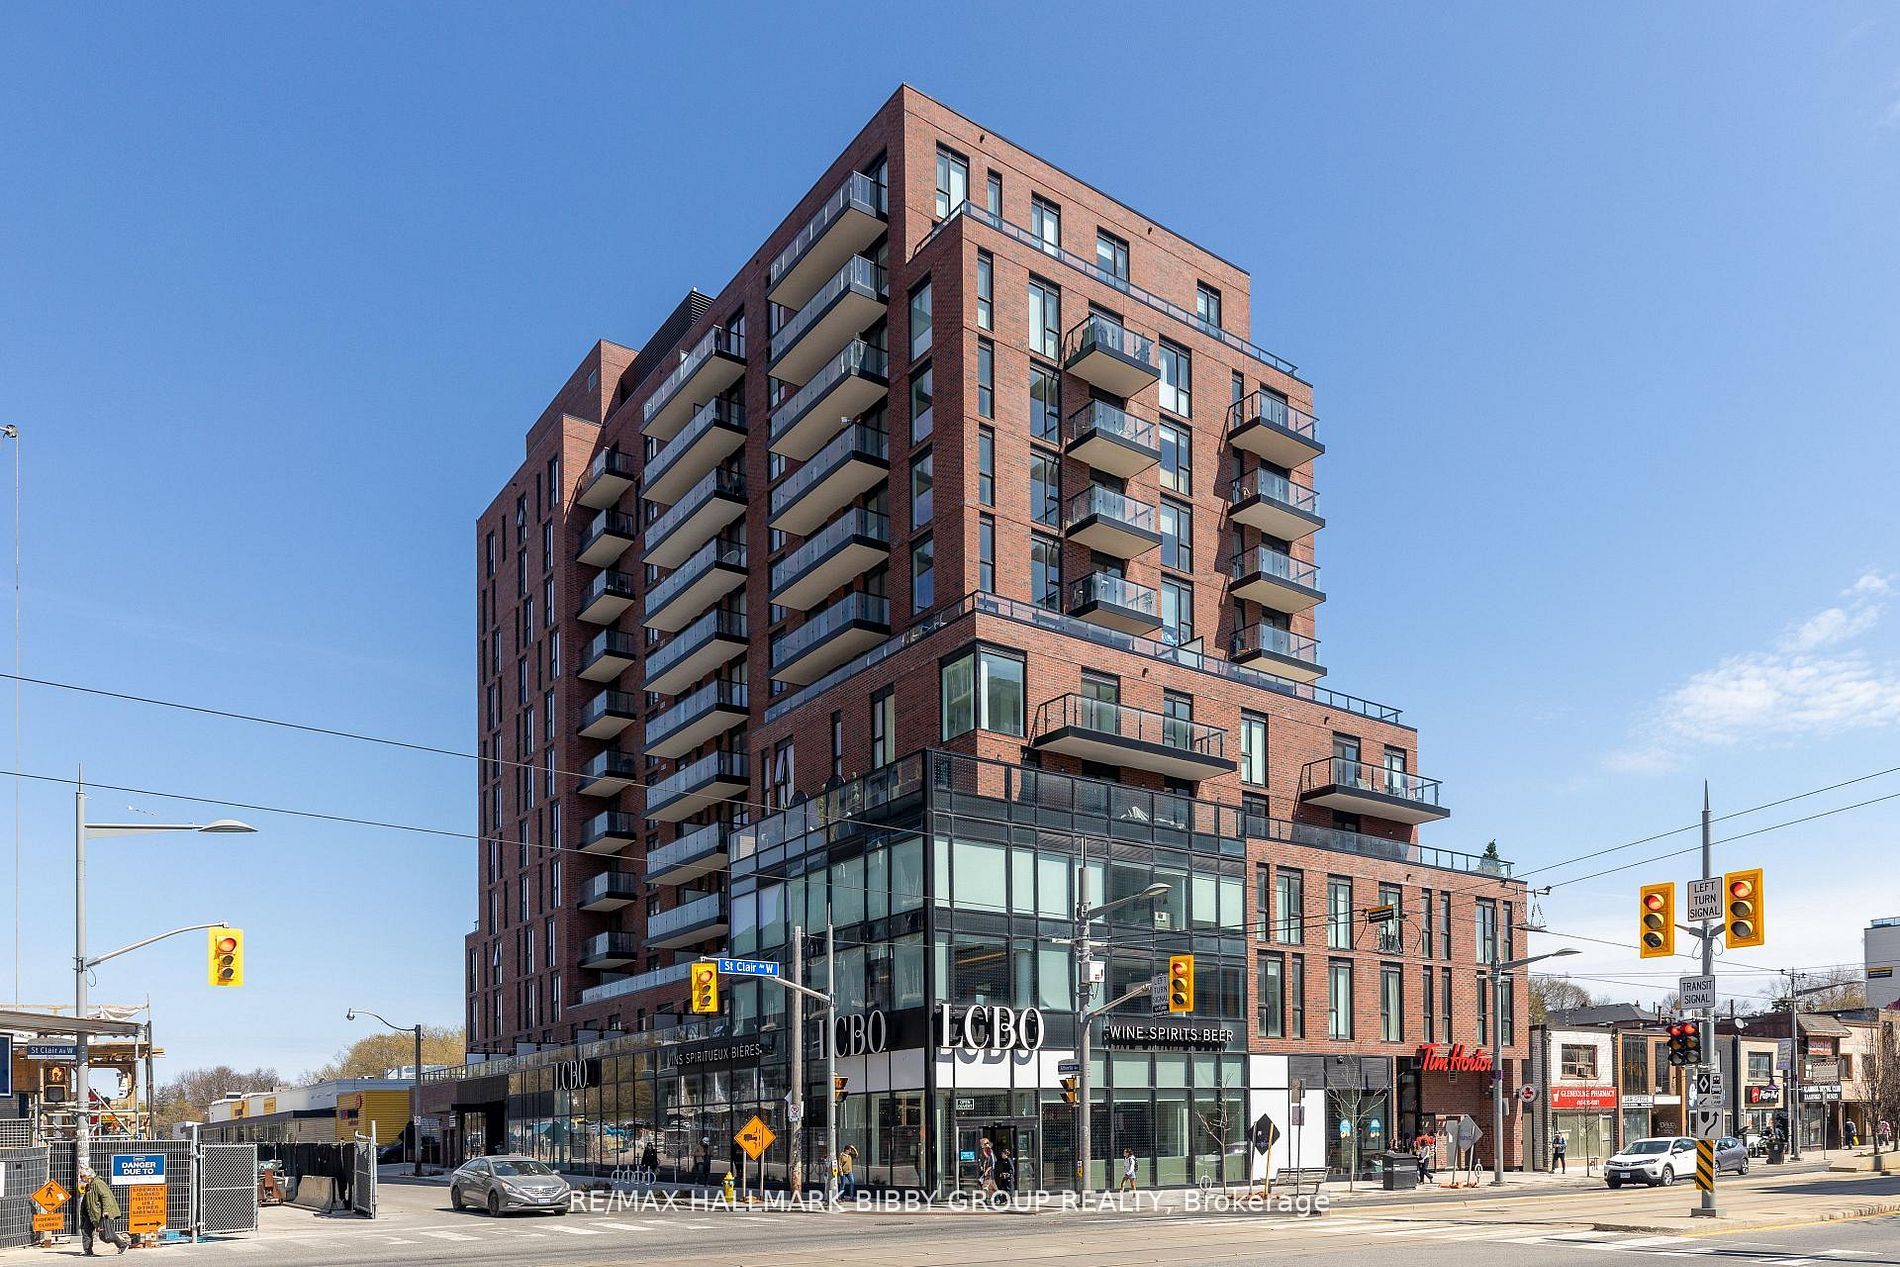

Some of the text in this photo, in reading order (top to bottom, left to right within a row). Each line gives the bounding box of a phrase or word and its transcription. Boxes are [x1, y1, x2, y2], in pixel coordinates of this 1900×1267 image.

[1694, 881, 1715, 893] LEFT
[1694, 894, 1716, 905] TURN
[1689, 906, 1720, 918] SIGNAL
[725, 961, 734, 971] St
[736, 961, 757, 973] Clair
[765, 963, 774, 974] W
[1154, 976, 1167, 985] LEFT
[1682, 980, 1712, 992] TRANSIT
[1154, 986, 1168, 994] TURN
[1153, 995, 1168, 1004] SIGNAL
[1684, 993, 1710, 1004] SIGNAL
[940, 1003, 1045, 1050] LCBO
[1109, 1025, 1234, 1041] WINE SPIRITS BEER
[40, 1046, 57, 1054] Clair
[685, 1050, 729, 1066] SPIRITUEUX
[1419, 1043, 1492, 1072] Tim Horton
[555, 1059, 588, 1091] LCBO
[121, 1161, 156, 1169] DANGER
